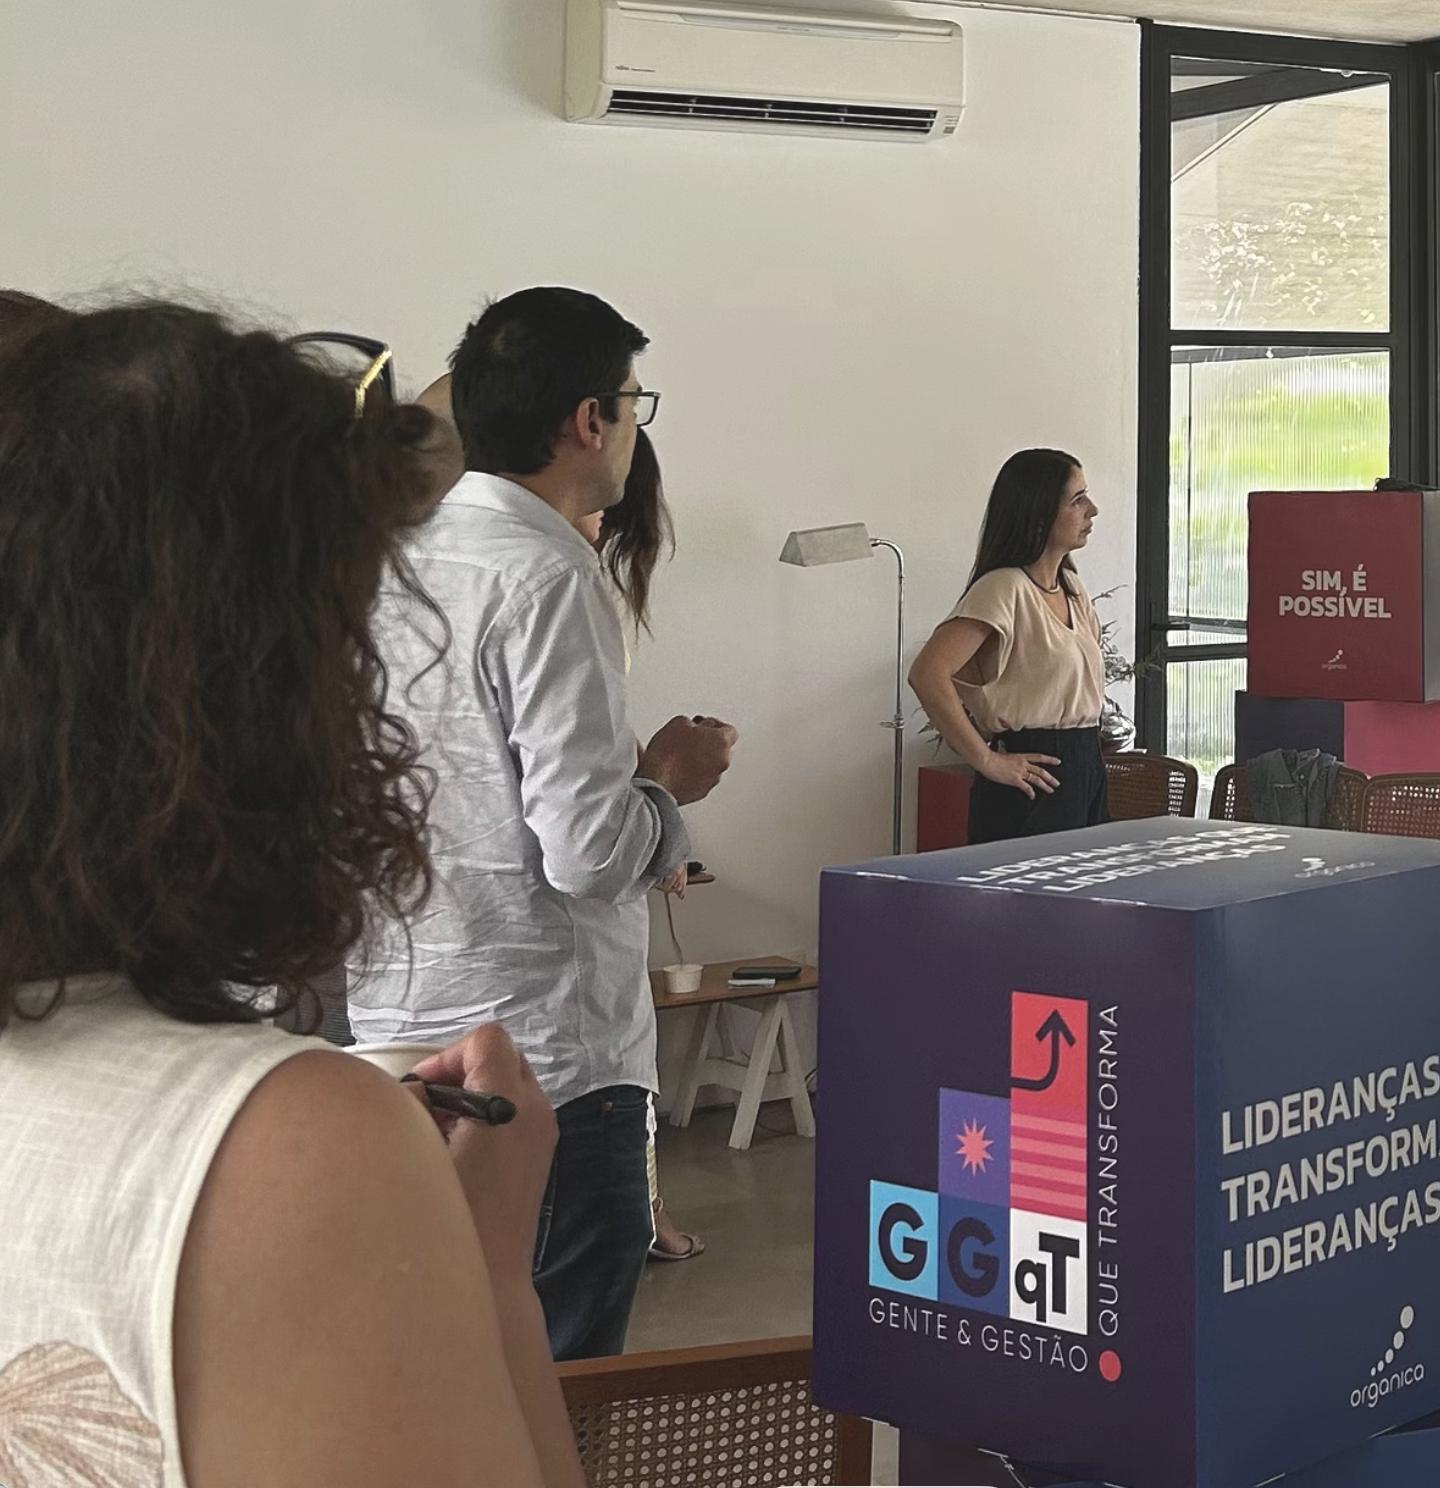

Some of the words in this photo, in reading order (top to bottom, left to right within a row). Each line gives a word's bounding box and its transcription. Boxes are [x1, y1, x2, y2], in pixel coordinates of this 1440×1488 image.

[1279, 588, 1392, 618] POSSÍVEL
[1302, 570, 1346, 593] SIM,
[1353, 564, 1367, 591] É
[1098, 1005, 1119, 1247] TRANSFORMA
[869, 1298, 948, 1340] GENTE
[957, 1319, 972, 1346] &
[981, 1324, 1089, 1373] GESTÃO
[1098, 1261, 1119, 1337] QUE
